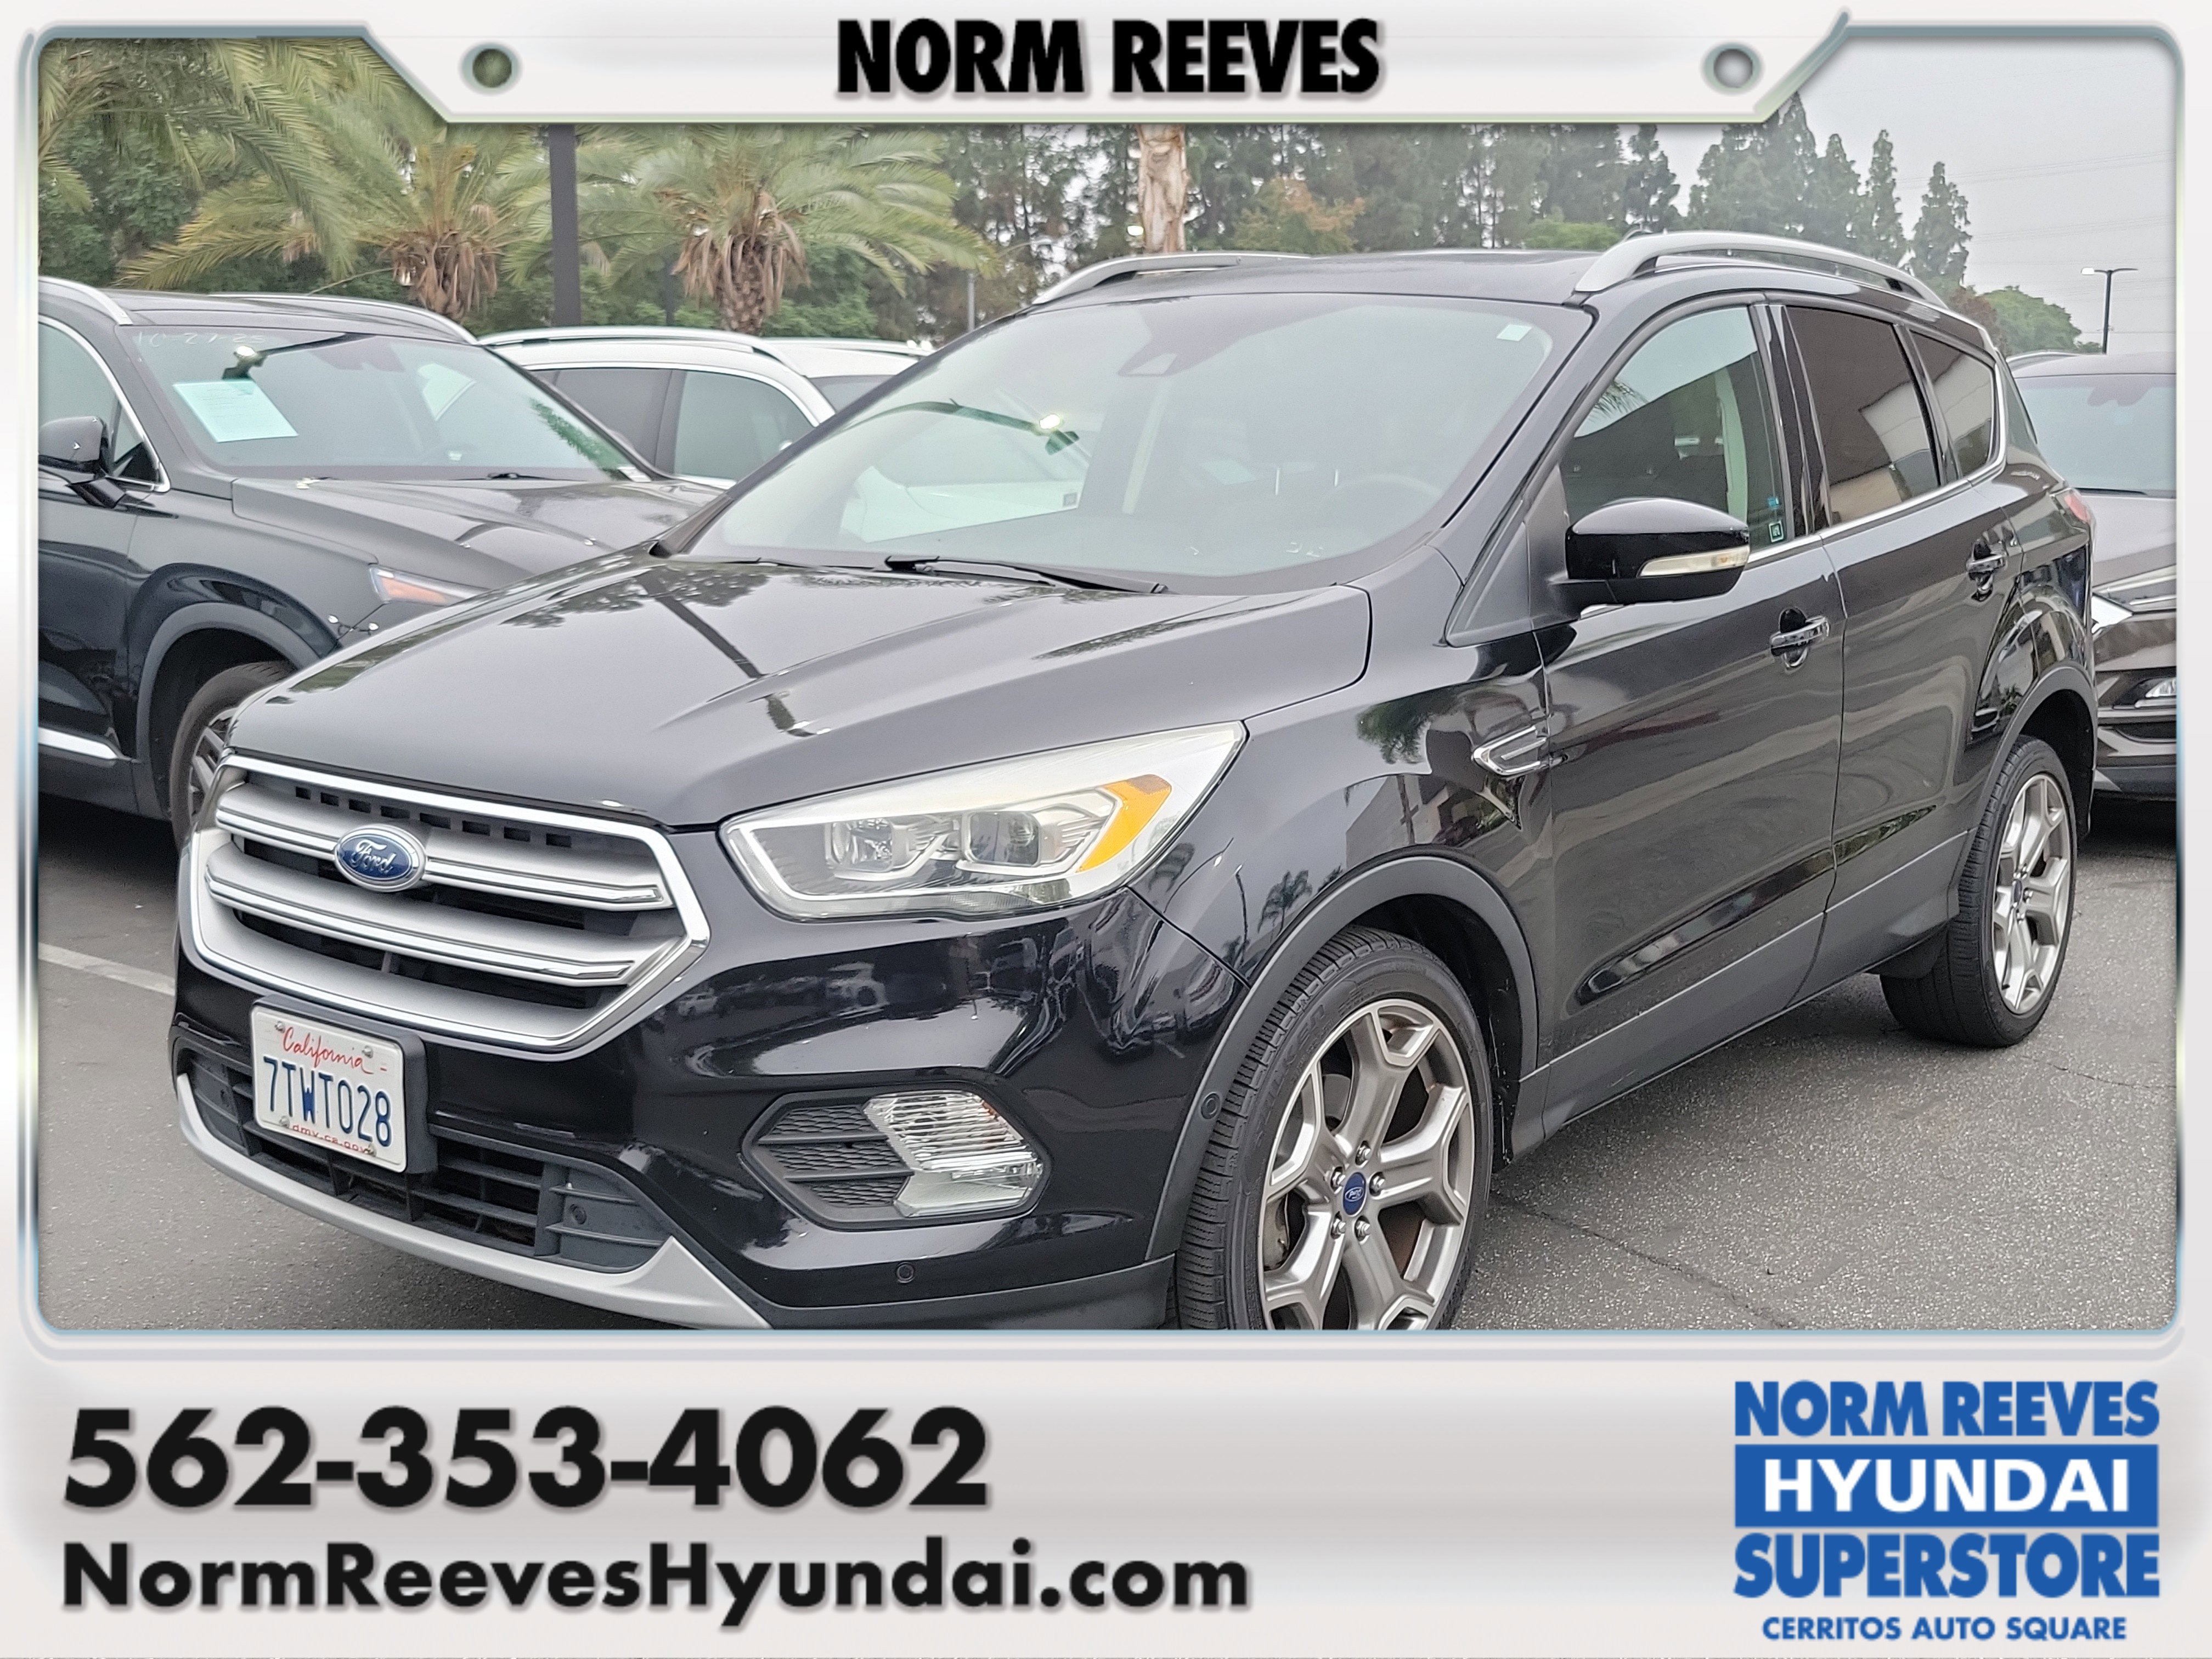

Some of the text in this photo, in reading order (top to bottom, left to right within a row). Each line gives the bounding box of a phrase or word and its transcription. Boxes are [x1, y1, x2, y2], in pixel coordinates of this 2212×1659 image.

[350, 839, 397, 875] Ford
[283, 1026, 375, 1075] California
[263, 1056, 392, 1147] 7TWT028
